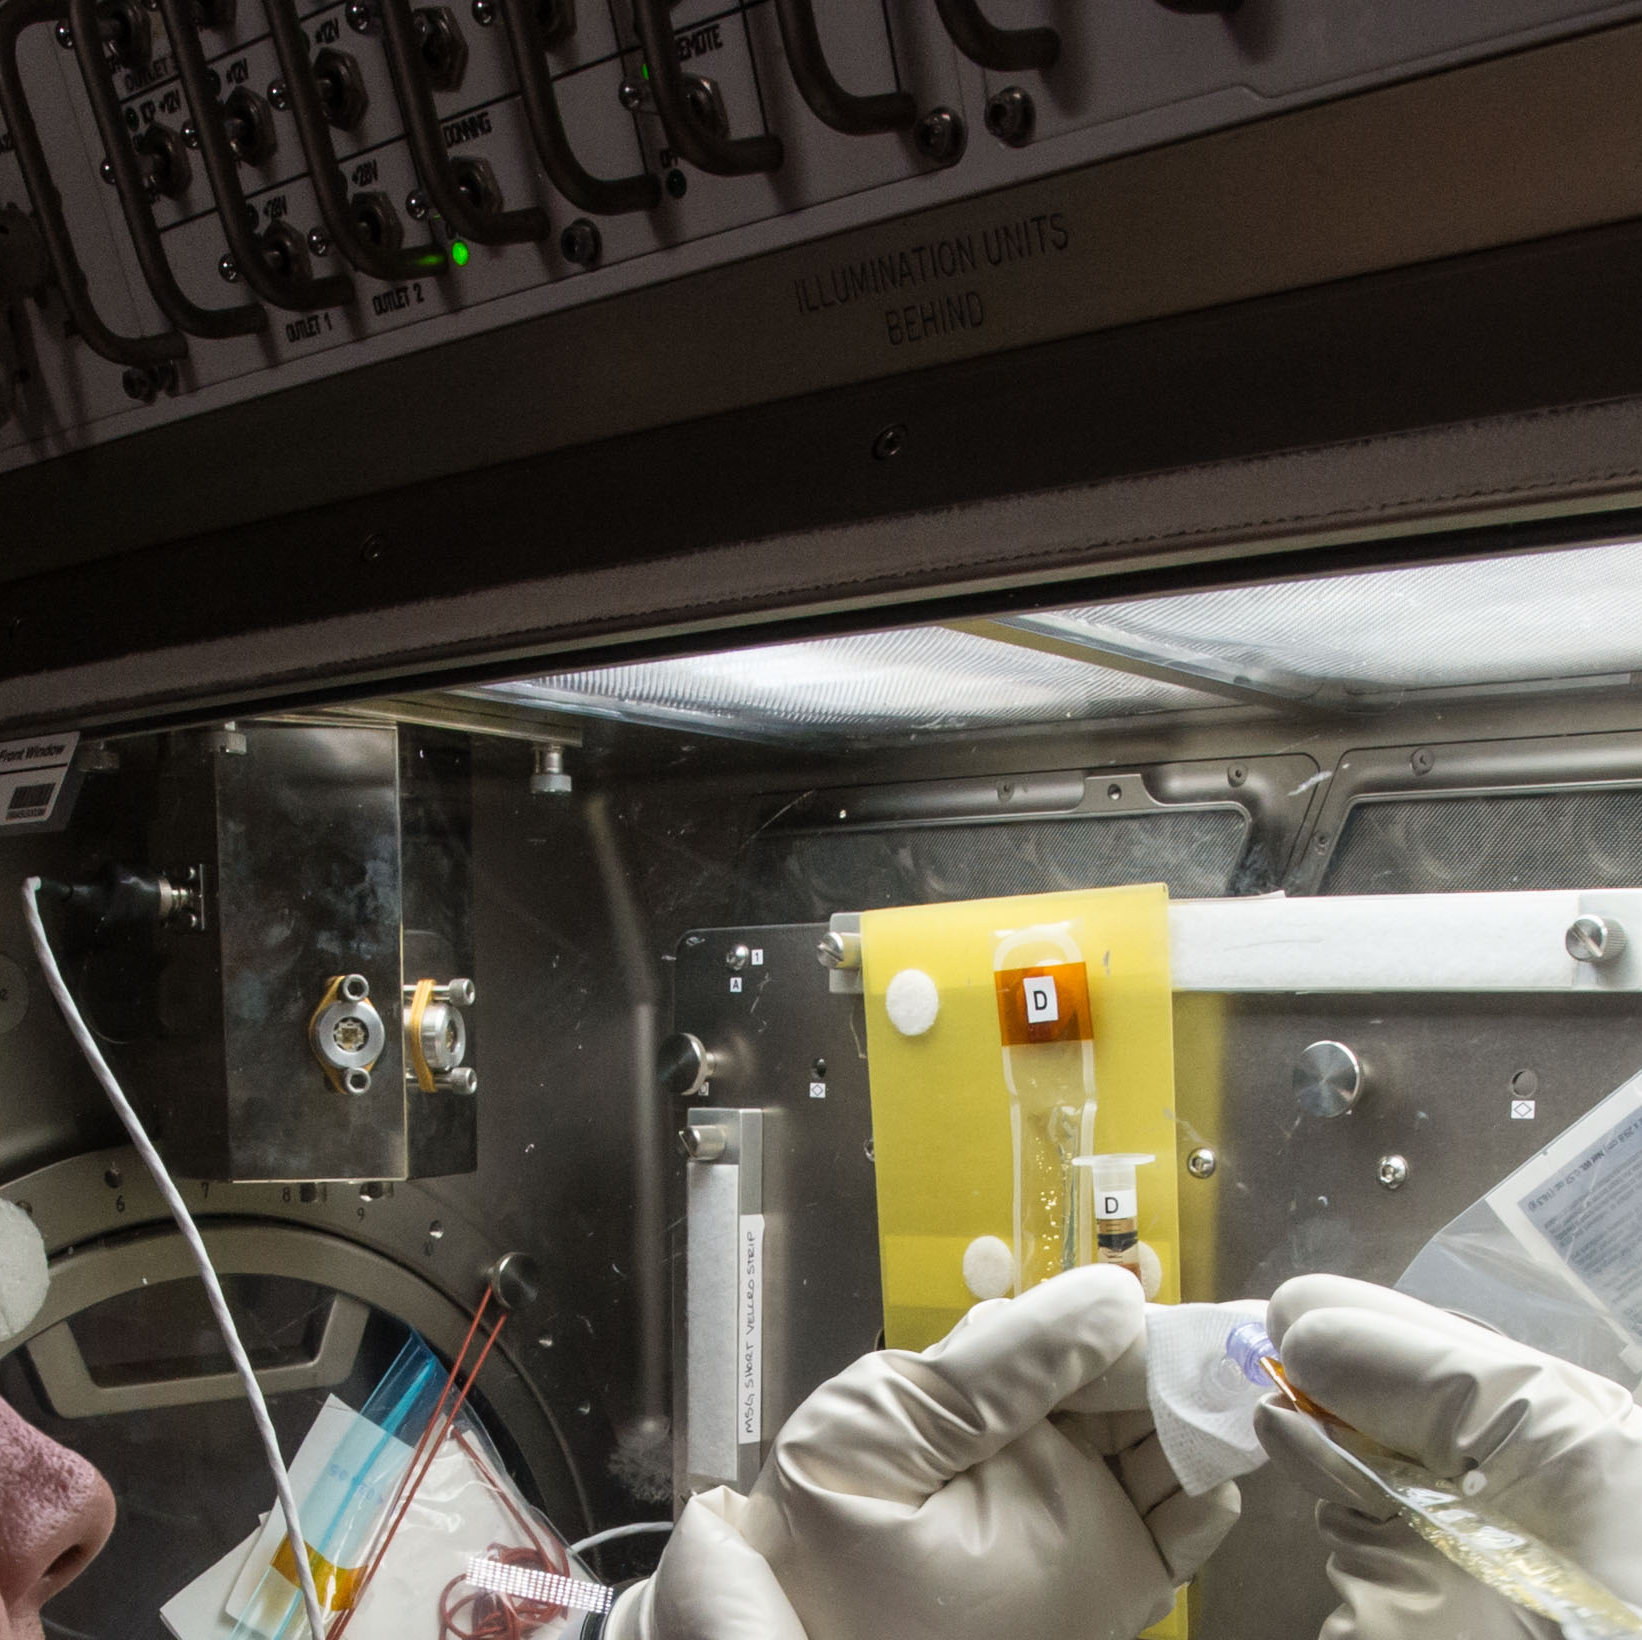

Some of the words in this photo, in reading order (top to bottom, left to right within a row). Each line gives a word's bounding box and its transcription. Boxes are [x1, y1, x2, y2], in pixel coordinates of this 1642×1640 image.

[678, 26, 724, 61] EMOTE
[794, 233, 977, 316] ILLUMINATION
[982, 212, 1069, 267] UNITS
[413, 283, 425, 302] 2
[884, 289, 985, 346] BEHIND
[25, 744, 67, 759] Window
[732, 979, 740, 990] A
[1033, 989, 1048, 1011] D
[282, 1185, 292, 1203] 8
[115, 1199, 125, 1213] 6
[357, 1207, 366, 1223] 9
[1104, 1196, 1119, 1214] D
[746, 1231, 756, 1276] STRIP
[746, 1280, 755, 1336] VELCRO
[745, 1343, 754, 1389] SHORT
